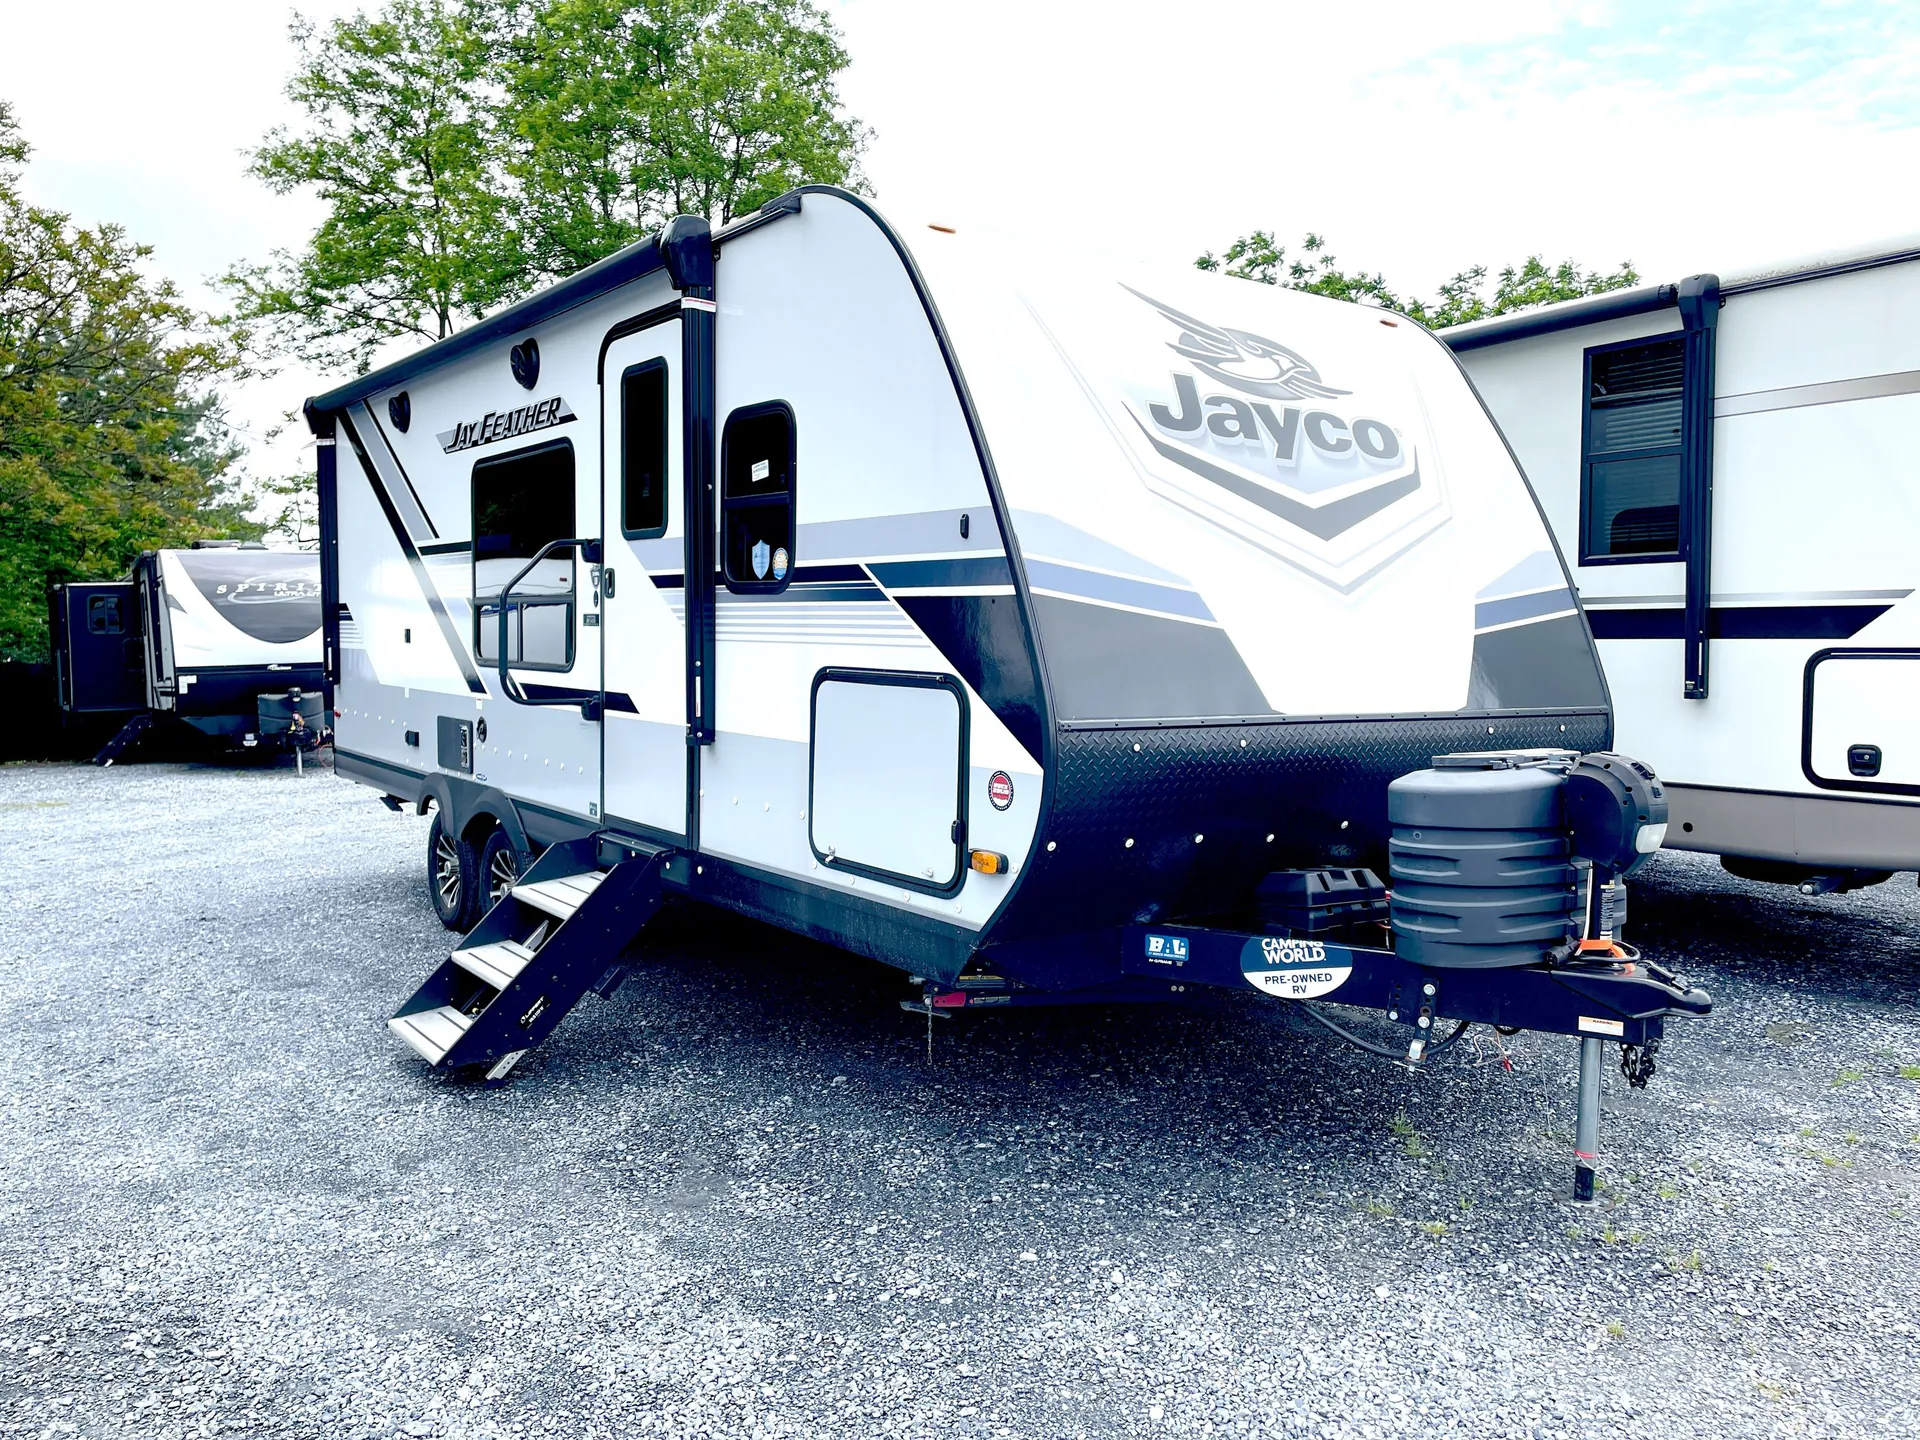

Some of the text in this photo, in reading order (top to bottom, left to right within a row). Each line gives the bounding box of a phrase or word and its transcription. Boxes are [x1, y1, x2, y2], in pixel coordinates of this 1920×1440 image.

[446, 396, 562, 451] JAY FEATHER
[1147, 372, 1401, 462] Jayco
[216, 582, 321, 594] SPIRIT
[1149, 936, 1186, 955] BAL
[1264, 973, 1332, 984] PRE-OWNED
[1292, 985, 1307, 994] RV
